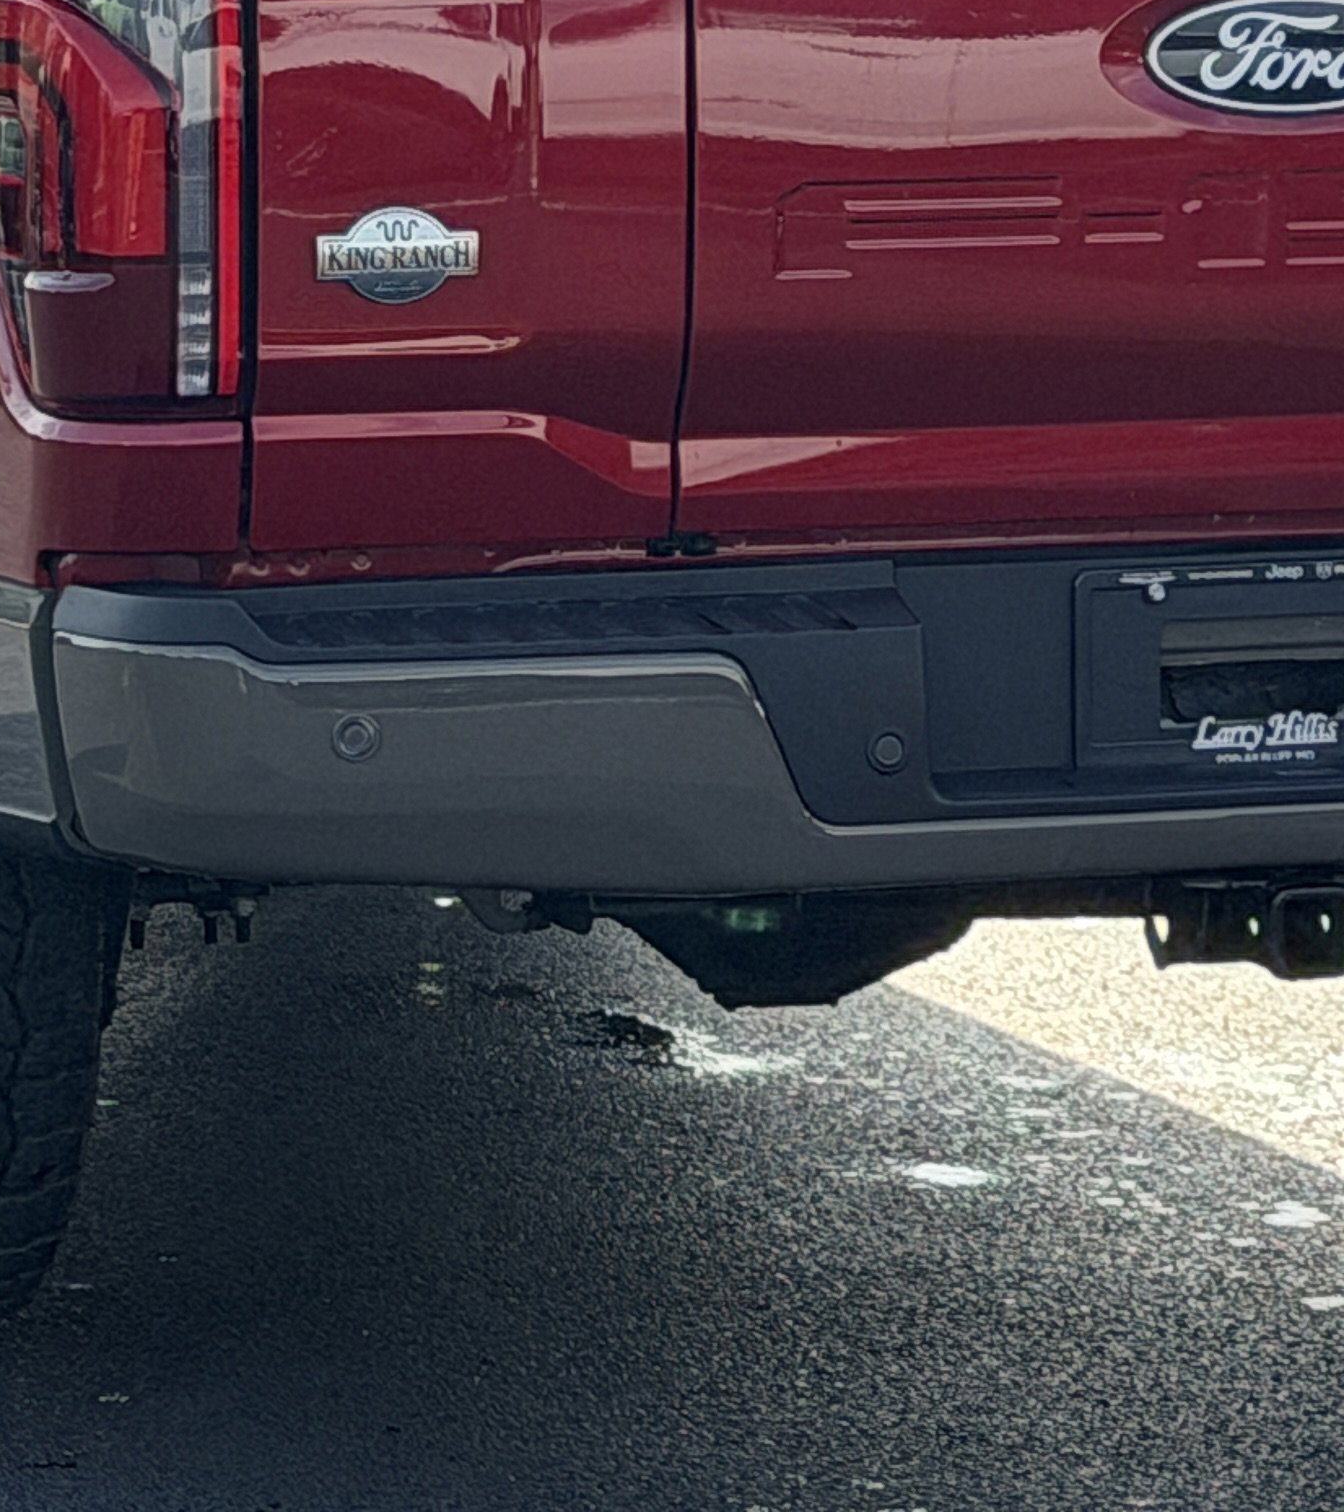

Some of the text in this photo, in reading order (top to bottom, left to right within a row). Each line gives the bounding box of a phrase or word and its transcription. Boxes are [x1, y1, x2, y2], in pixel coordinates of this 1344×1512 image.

[326, 239, 471, 272] KING RANCH
[1265, 564, 1304, 580] Jeep
[1192, 710, 1339, 751] Larry Hillis
